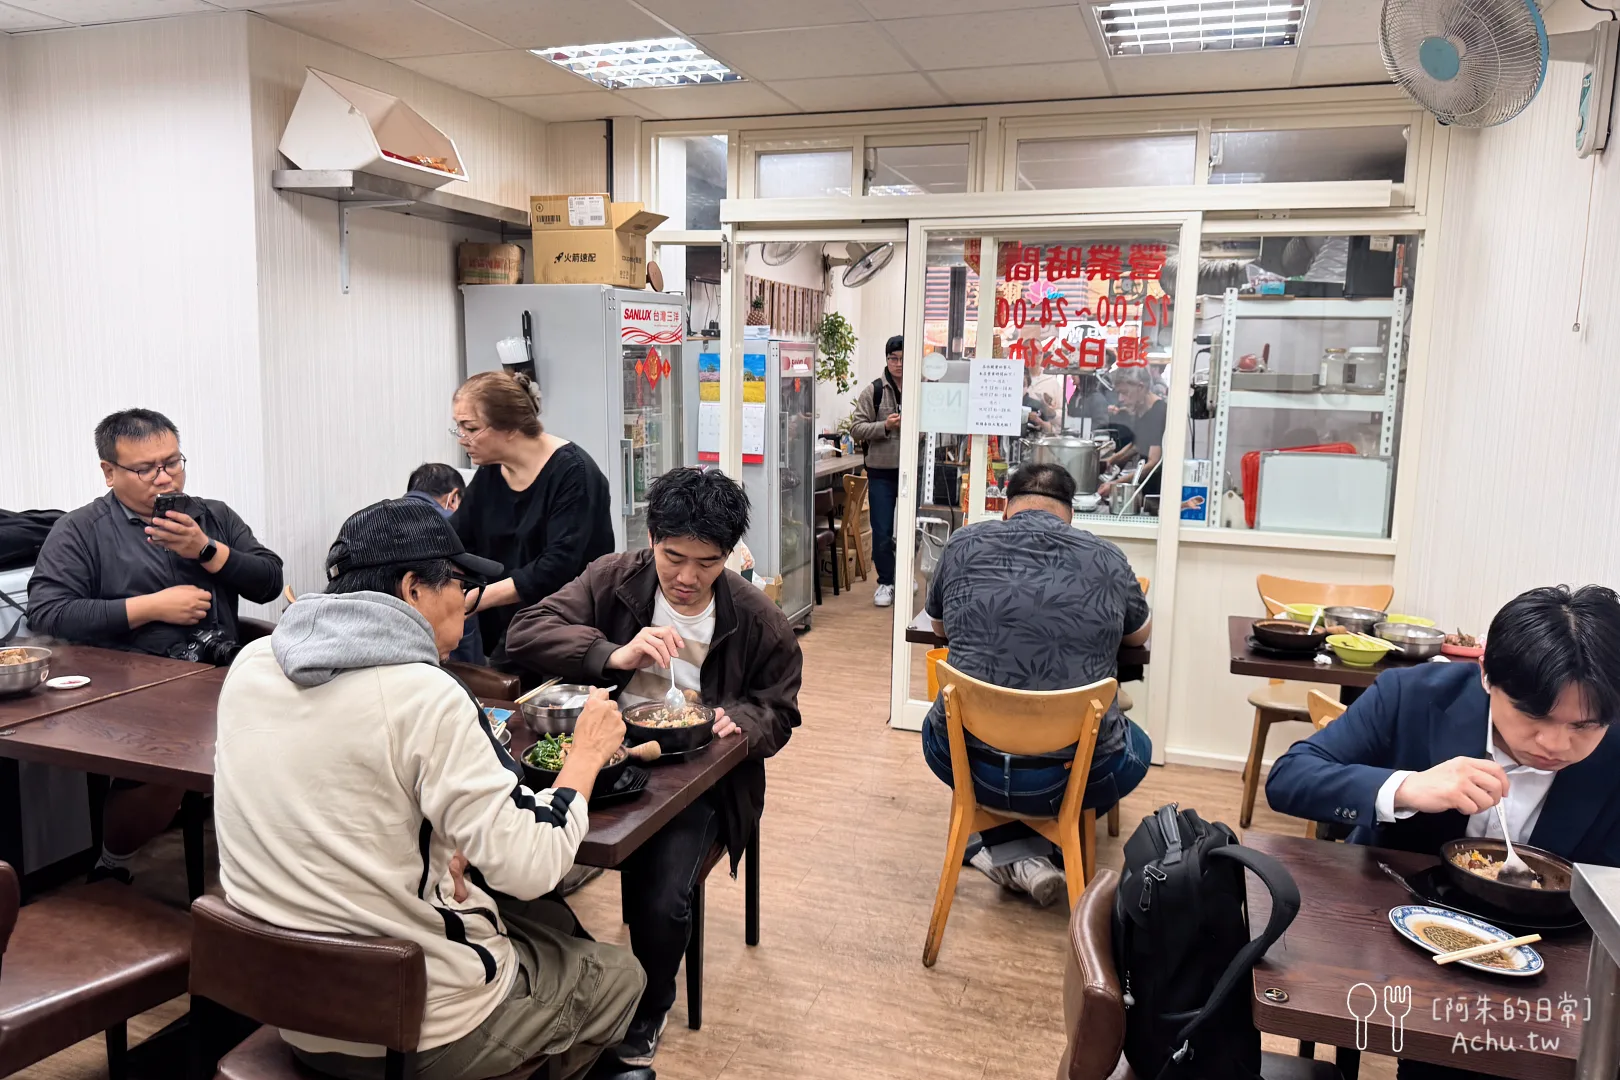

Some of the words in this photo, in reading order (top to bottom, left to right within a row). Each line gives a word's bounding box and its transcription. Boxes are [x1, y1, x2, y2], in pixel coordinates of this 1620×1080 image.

[563, 252, 597, 263] 火箭速配
[624, 308, 652, 321] SANLUX
[653, 310, 680, 322] 台灣三洋
